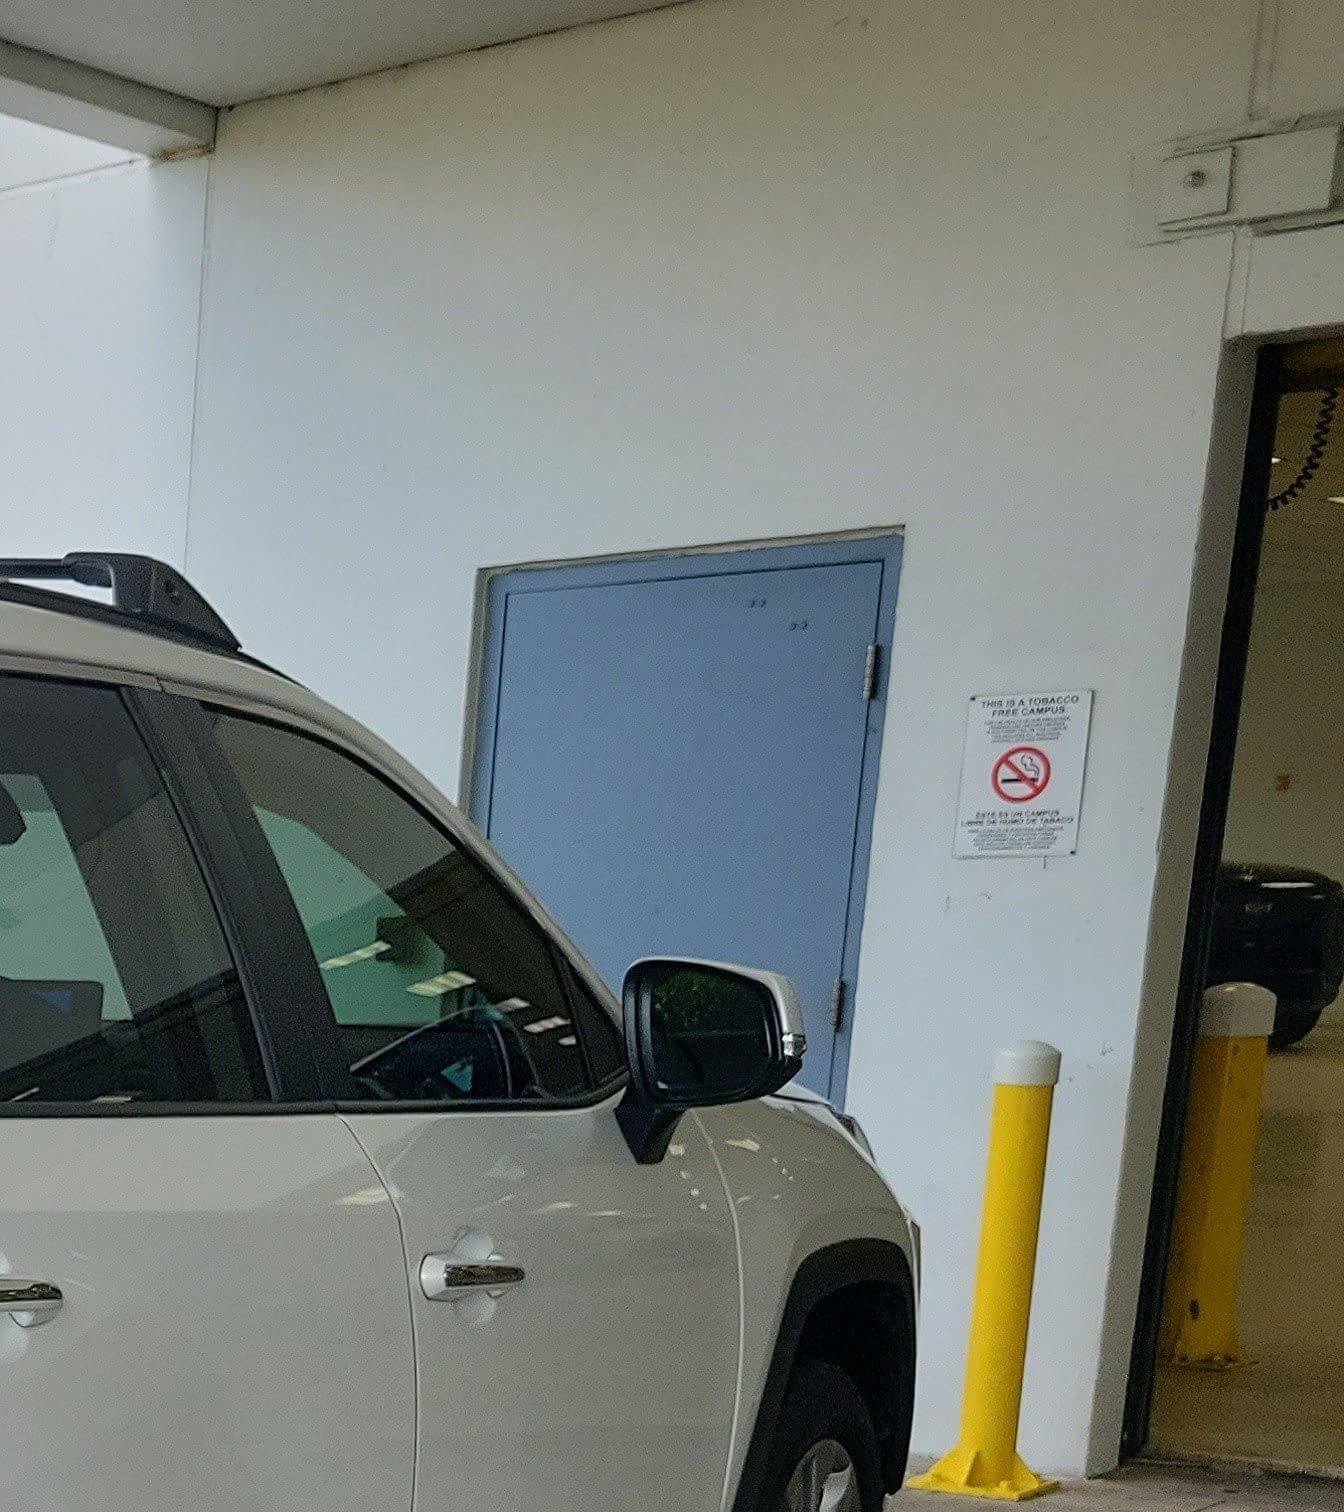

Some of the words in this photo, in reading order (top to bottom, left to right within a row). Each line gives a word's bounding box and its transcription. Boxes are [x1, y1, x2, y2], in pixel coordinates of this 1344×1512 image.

[981, 700, 1003, 708] THIS
[1006, 699, 1015, 707] IS
[1018, 698, 1025, 706] A
[1029, 695, 1080, 706] TOBACCO
[991, 708, 1018, 717] FREE
[1021, 705, 1066, 716] CAMPUS
[1024, 809, 1061, 817] CAMPUS
